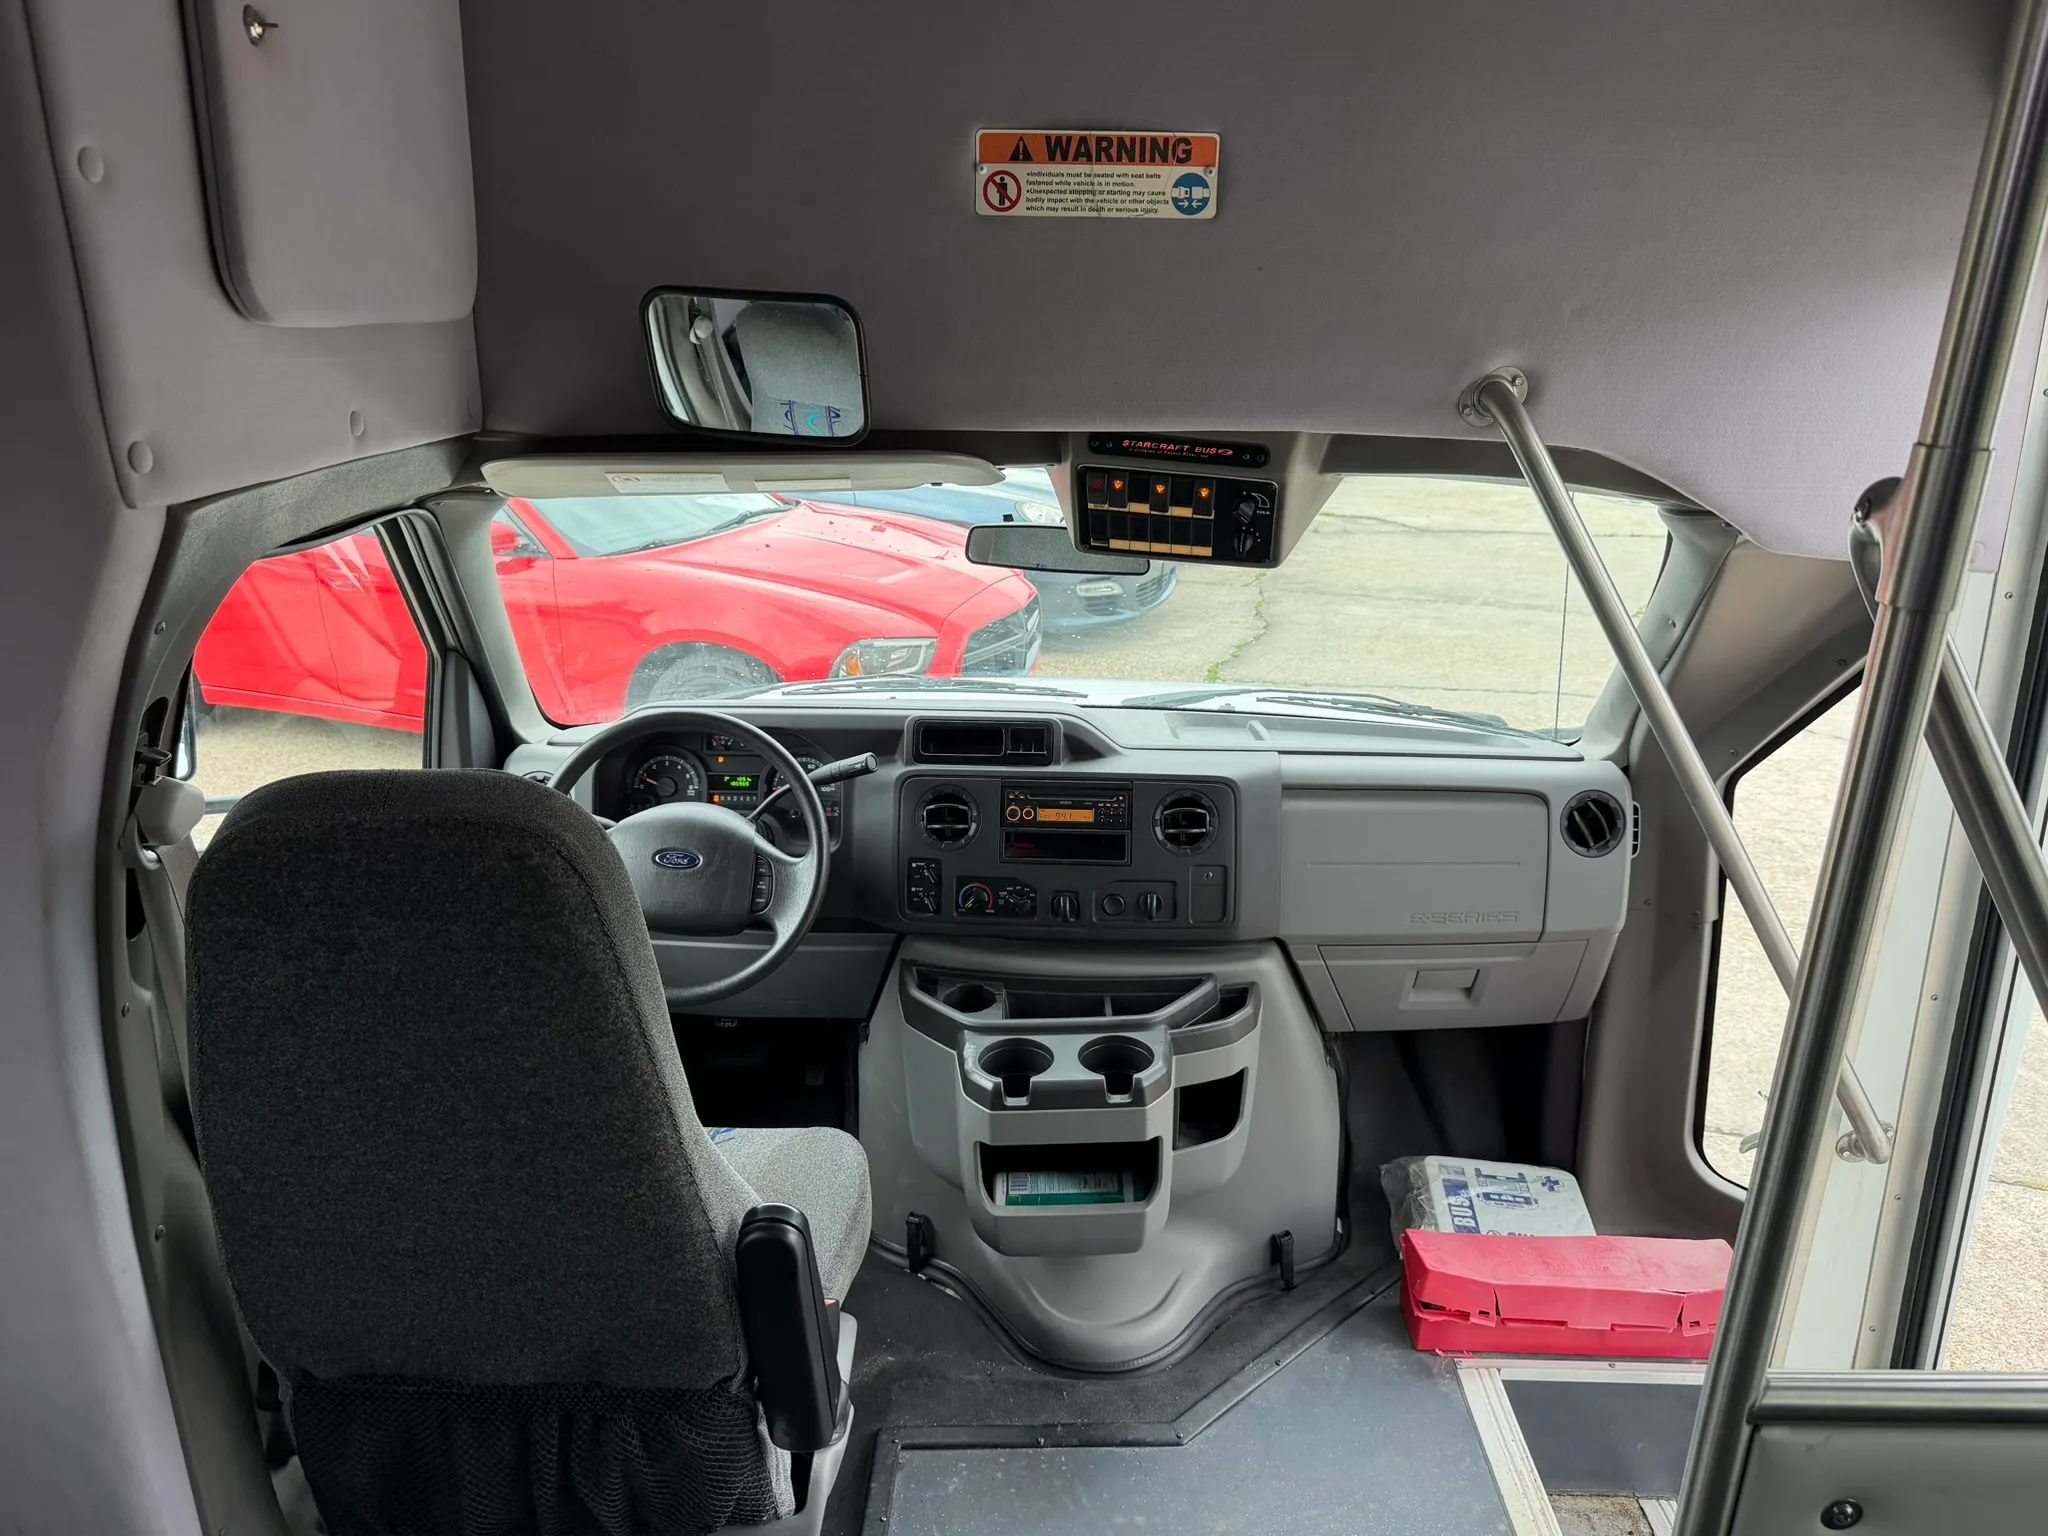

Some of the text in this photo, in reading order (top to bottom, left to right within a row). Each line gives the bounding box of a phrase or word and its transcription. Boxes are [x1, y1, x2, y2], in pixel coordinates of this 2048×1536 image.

[1044, 135, 1193, 164] WARNING
[1030, 170, 1065, 178] Individuals
[1122, 440, 1217, 454] STARCRAFT BUS
[663, 854, 689, 864] Ford
[1448, 1195, 1477, 1228] BUS
